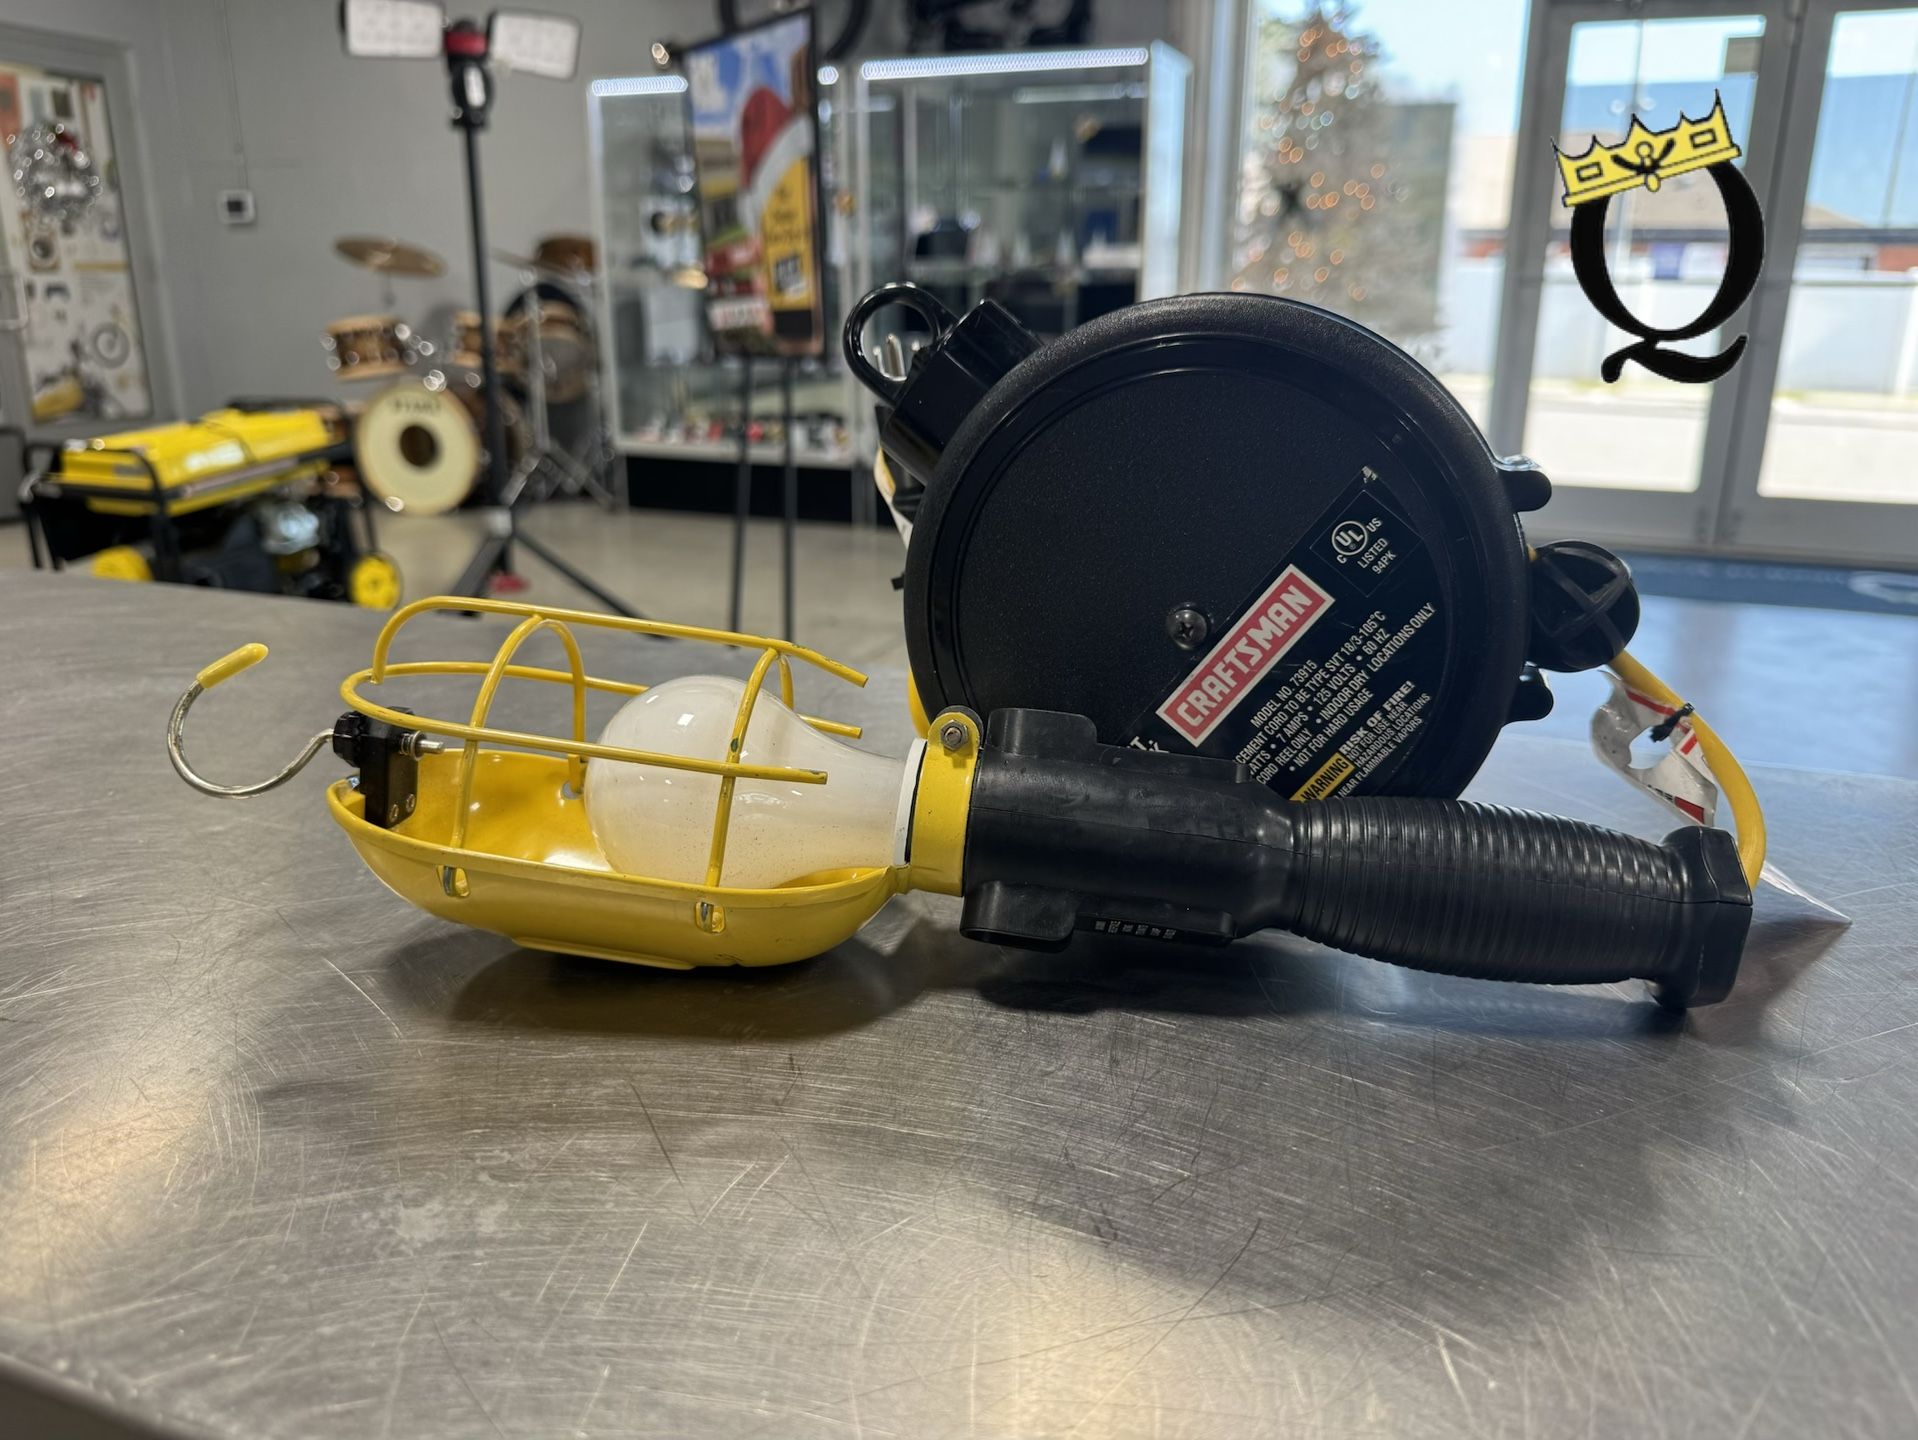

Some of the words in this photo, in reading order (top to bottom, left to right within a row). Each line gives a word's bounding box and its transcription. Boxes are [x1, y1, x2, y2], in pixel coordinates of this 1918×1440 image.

[1335, 529, 1364, 549] UL
[1365, 517, 1381, 532] US
[1357, 537, 1387, 568] LISTED
[1371, 550, 1395, 574] 94PK
[1177, 585, 1312, 725] CRAFTSMAN
[1232, 731, 1267, 767] CEMENT
[1263, 711, 1288, 735] CORD
[1283, 699, 1299, 713] TO
[1294, 688, 1310, 703] BE
[1304, 668, 1329, 691] TYPE
[1324, 652, 1344, 671] SVT
[1248, 750, 1270, 774] ATTS
[1275, 733, 1286, 742] 7
[1282, 711, 1308, 737] AMPS
[1313, 687, 1331, 704] 125
[1326, 663, 1355, 690] VOLTS
[1361, 640, 1377, 654] 60
[1372, 628, 1390, 643] HZ
[1250, 699, 1281, 727] MODEL
[1275, 685, 1294, 701] NO.
[1289, 659, 1317, 686] 73915
[1255, 762, 1278, 784] CORD
[1274, 746, 1297, 765] REEL
[1290, 727, 1312, 749] ONLY
[1319, 686, 1354, 720] INDOOR
[1348, 669, 1369, 690] DRY
[1366, 624, 1414, 671] LOCATIONS
[1409, 602, 1434, 628] ONLY
[1293, 747, 1312, 767] NOT
[1307, 733, 1328, 752] FOR
[1322, 713, 1347, 737] HARD
[1342, 687, 1373, 716] USAGE
[1338, 726, 1368, 754] RISK
[1366, 710, 1382, 727] OF
[1382, 680, 1414, 711] FIRE!
[1353, 727, 1395, 767] HAZARDOUS
[1391, 693, 1430, 730] LOCATIONS
[1337, 778, 1358, 797] NEAR
[1354, 741, 1396, 780] FLAMMABLE
[1392, 715, 1422, 743] VAPORS
[1346, 744, 1362, 760] NOT
[1359, 732, 1376, 747] FOR
[1372, 718, 1390, 734] USE
[1386, 701, 1408, 721] NEAR
[1300, 757, 1349, 802] WARNING
